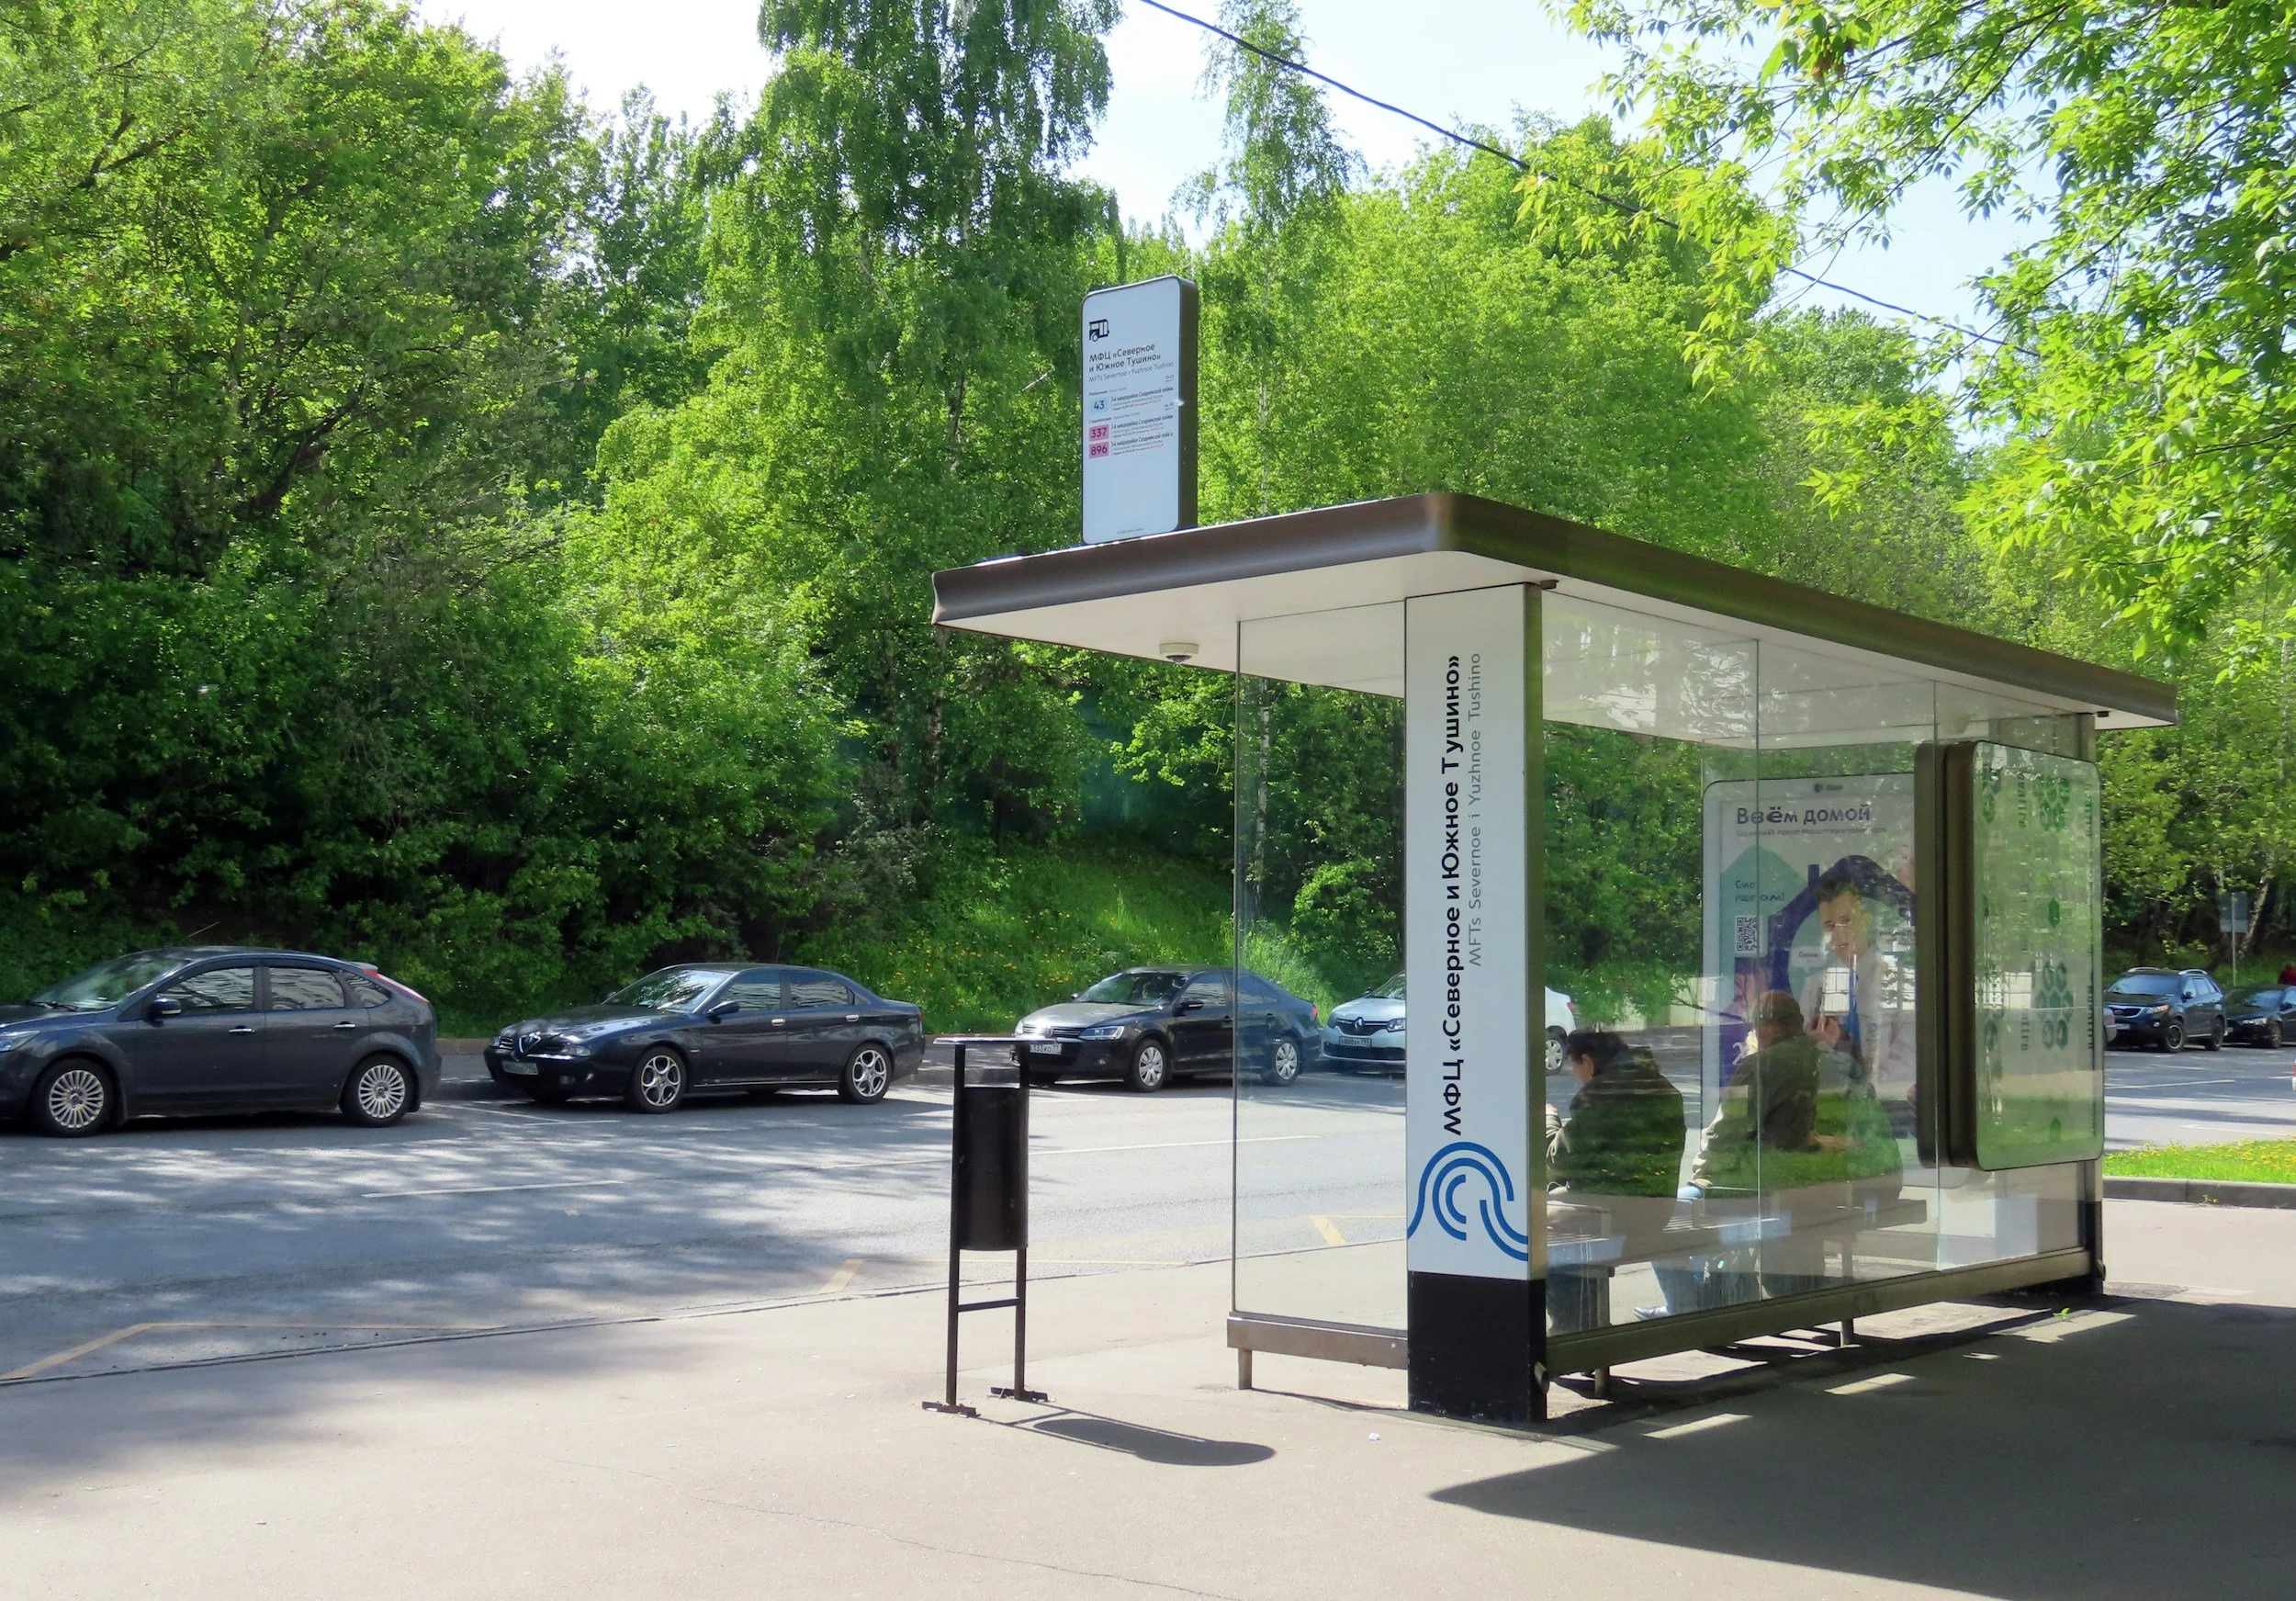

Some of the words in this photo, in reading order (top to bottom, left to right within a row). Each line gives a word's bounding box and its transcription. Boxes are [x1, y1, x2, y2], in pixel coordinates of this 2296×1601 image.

[1089, 351, 1111, 363] МФЦ
[1112, 344, 1155, 358] «Северное
[1096, 360, 1125, 372] Южное
[1127, 355, 1161, 366] Тушино»
[1094, 400, 1105, 411] 43
[1090, 427, 1108, 439] 337
[1090, 445, 1108, 456] 896
[1467, 652, 1481, 723] Tushino
[1441, 655, 1465, 775] Тушино»
[1468, 729, 1481, 806] Yuzhnoe
[1440, 782, 1460, 880] Южное
[1803, 804, 1871, 825] домой
[1446, 885, 1460, 900] и
[1468, 826, 1481, 910] Severnoe
[1469, 917, 1482, 967] MFTs
[1442, 907, 1465, 1052] «Северное
[1442, 1058, 1465, 1136] МФЦ
